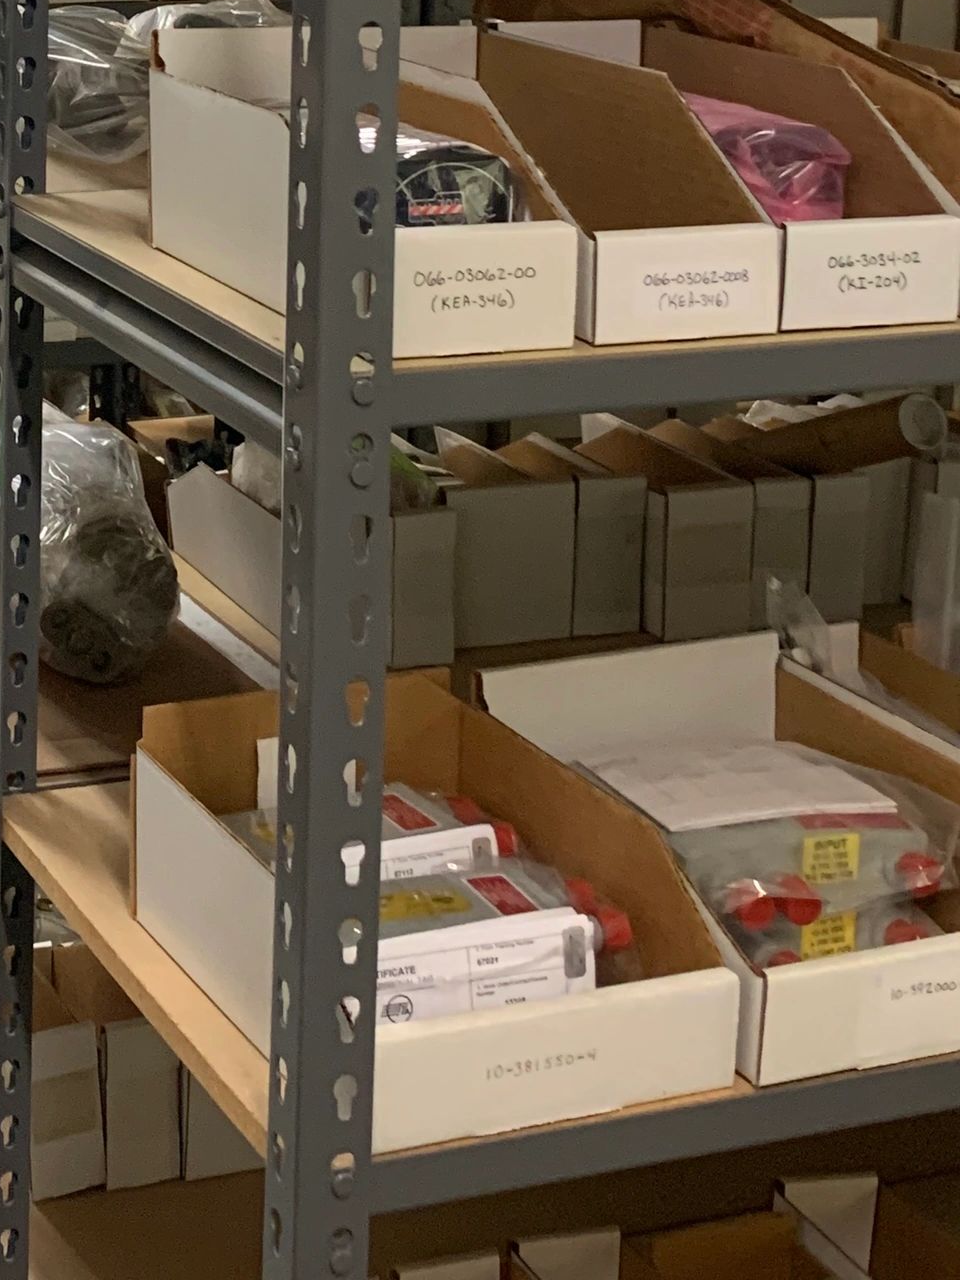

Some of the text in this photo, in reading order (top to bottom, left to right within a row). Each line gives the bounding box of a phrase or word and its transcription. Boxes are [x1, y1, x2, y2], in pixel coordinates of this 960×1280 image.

[827, 251, 921, 269] 066-3034-02
[413, 266, 536, 287] 066-03062-00
[838, 271, 908, 293] (KI-204)
[431, 288, 516, 313] (KEA-346)
[658, 290, 729, 312] (KEA-346)
[377, 965, 416, 979] TIFICATE
